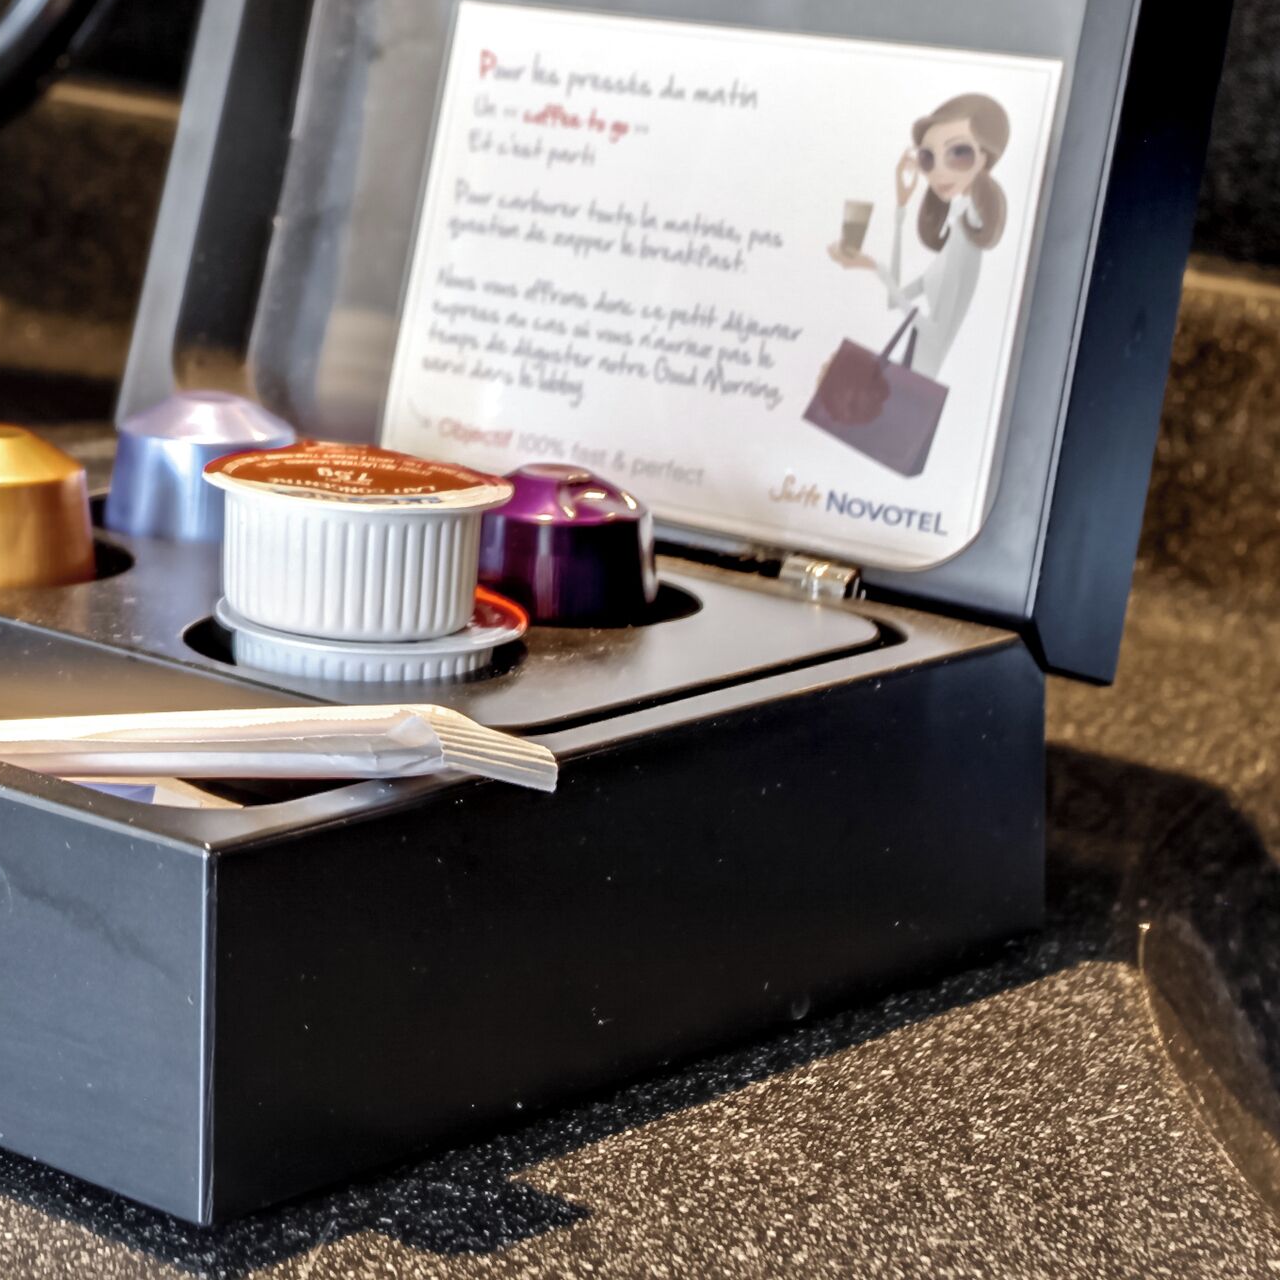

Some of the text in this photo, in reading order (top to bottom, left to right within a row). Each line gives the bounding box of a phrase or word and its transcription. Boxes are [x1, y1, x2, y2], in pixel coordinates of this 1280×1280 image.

[479, 49, 524, 80] Pour
[532, 53, 560, 86] les
[659, 72, 685, 100] du
[693, 78, 759, 109] matin
[523, 102, 580, 128] coffee
[587, 109, 605, 133] to
[610, 119, 629, 144] go
[547, 143, 595, 169] parti
[449, 213, 519, 239] question
[524, 221, 547, 244] de
[552, 231, 615, 258] zapper
[620, 231, 635, 257] le
[454, 177, 492, 205] Pour
[497, 188, 580, 219] carburer
[587, 199, 637, 228] toute
[640, 202, 657, 230] la
[747, 228, 783, 252] pas
[593, 290, 635, 317] donc
[669, 303, 717, 331] petit
[428, 322, 479, 351] temps
[485, 329, 508, 355] de
[598, 351, 648, 378] notre
[653, 356, 697, 387] Good
[717, 344, 752, 374] pas
[757, 339, 775, 370] le
[437, 417, 514, 447] Objectif
[516, 431, 565, 458] 100%
[571, 441, 607, 465] fast
[613, 450, 626, 471] &
[631, 456, 705, 486] perfect
[768, 474, 948, 536] Suite NOVOTEL
